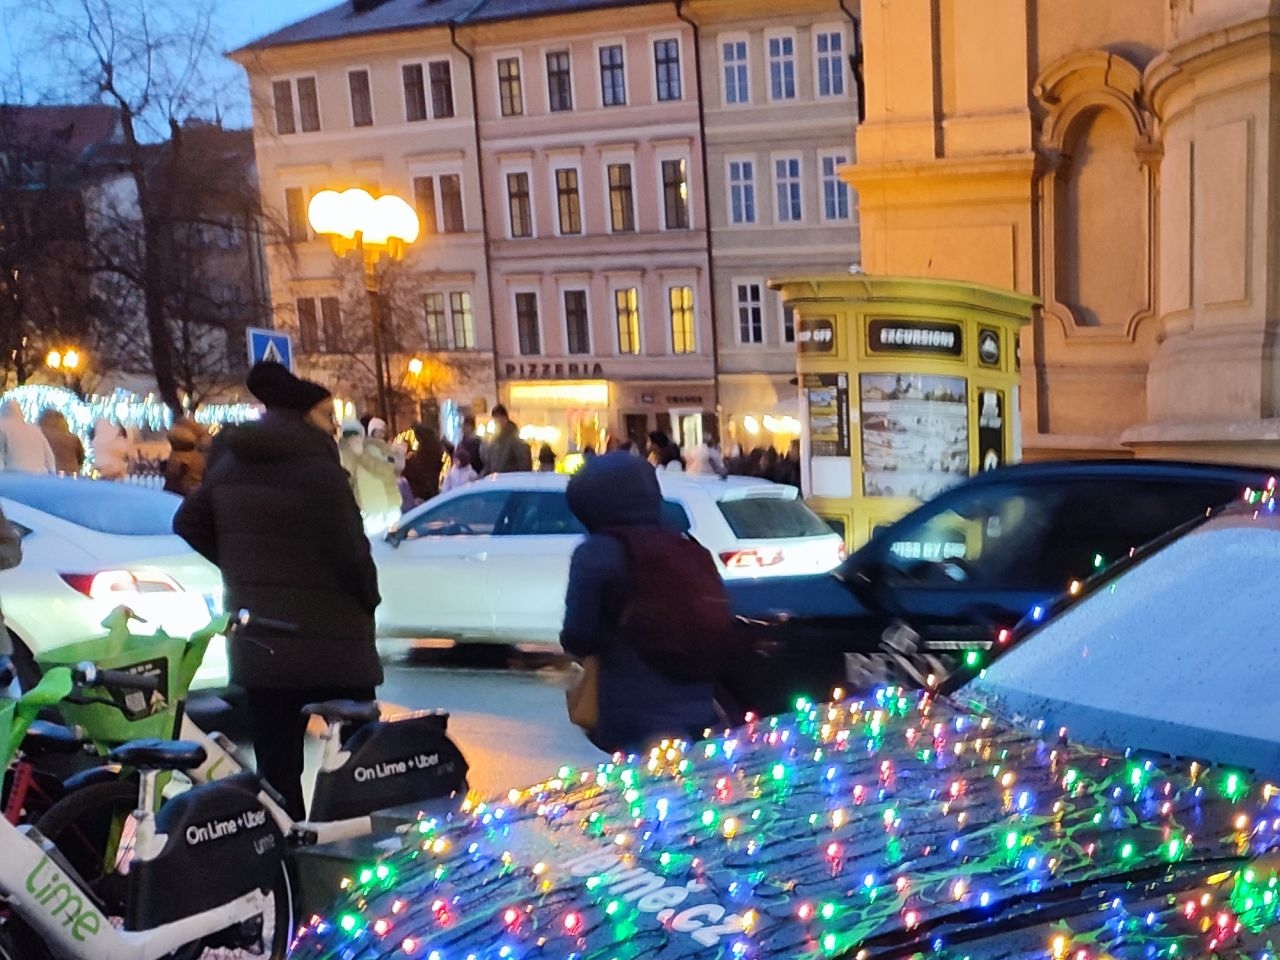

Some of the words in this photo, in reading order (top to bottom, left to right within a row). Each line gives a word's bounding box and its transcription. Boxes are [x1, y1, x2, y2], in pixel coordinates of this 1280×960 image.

[881, 328, 955, 348] EXCURSIONS
[506, 363, 603, 379] PIZZERIA
[354, 767, 375, 781] On
[376, 761, 407, 778] Lime
[415, 753, 439, 768] Uber
[186, 825, 208, 845] On
[207, 819, 238, 839] Lime
[243, 809, 266, 829] Uber
